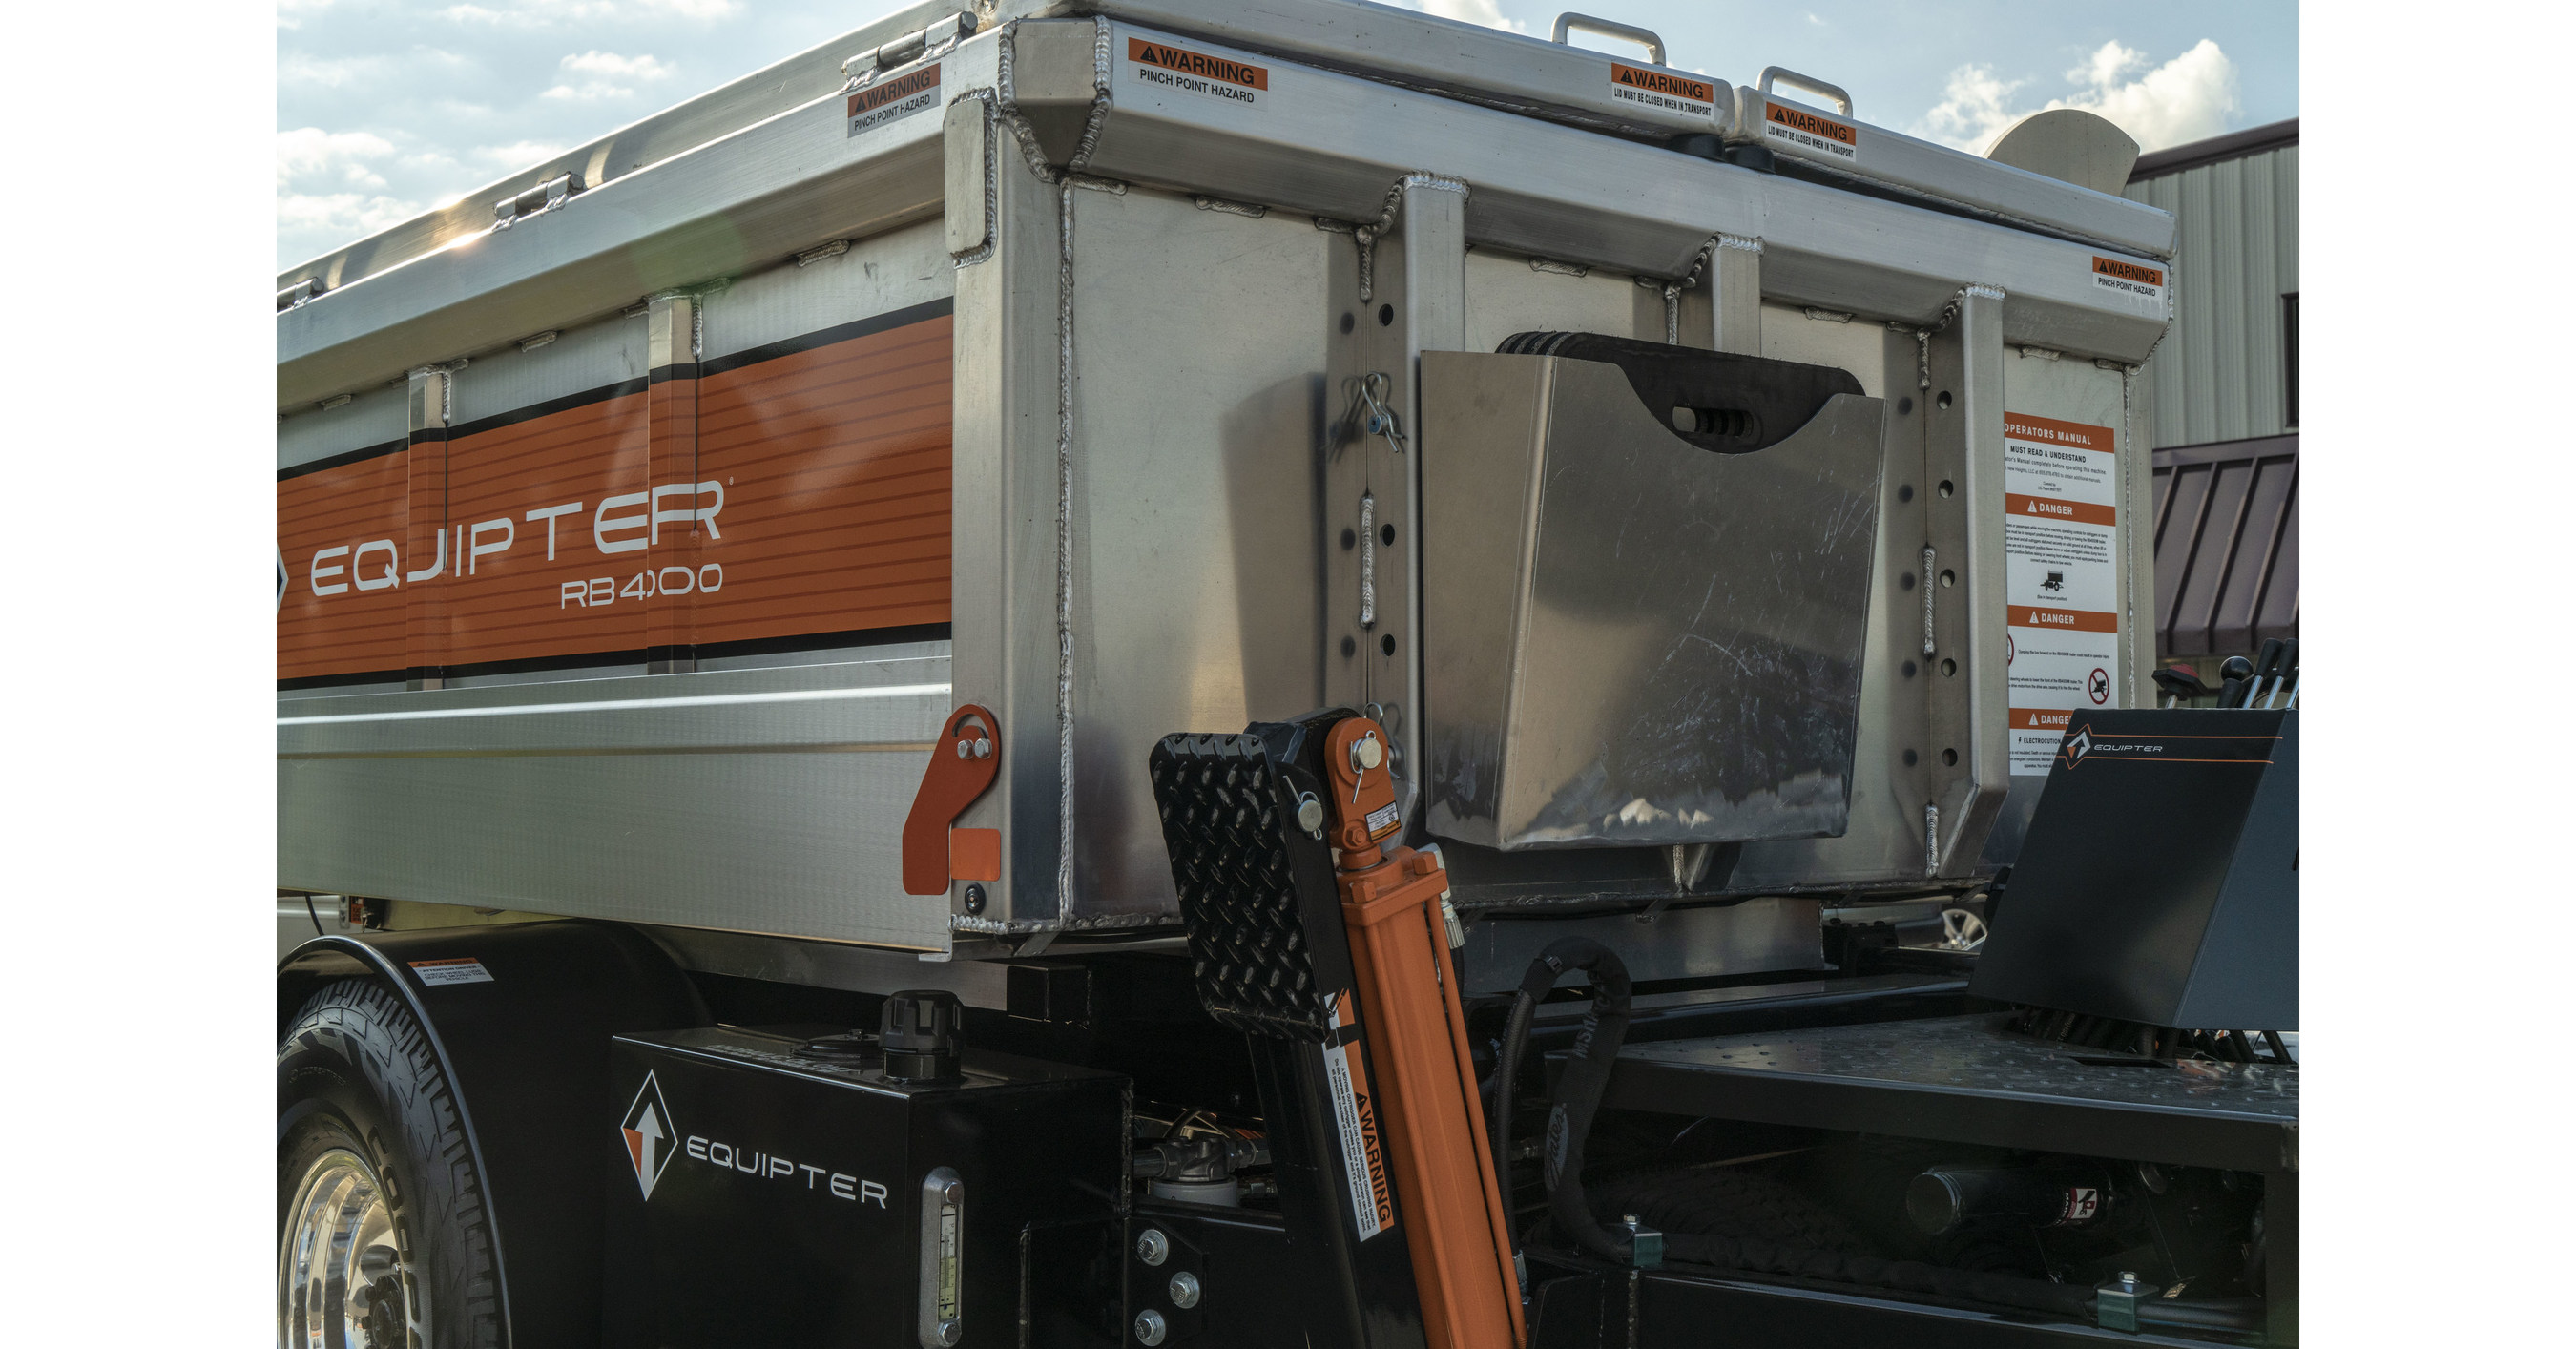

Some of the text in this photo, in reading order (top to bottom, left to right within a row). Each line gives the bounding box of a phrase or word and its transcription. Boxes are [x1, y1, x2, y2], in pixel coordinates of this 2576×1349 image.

[1159, 48, 1255, 85] WARNING
[866, 70, 930, 108] WARNING
[1140, 68, 1255, 103] PINCH POINT HAZARD
[1634, 71, 1703, 99] WARNING
[854, 93, 930, 131] PINCH POINT HAZARD
[1623, 89, 1636, 101] MUST
[1637, 92, 1644, 102] BE
[1645, 93, 1663, 107] CLOSED
[1664, 98, 1677, 110] WHEN
[1678, 100, 1684, 111] IN
[1684, 102, 1711, 116] TRANSPORT
[1786, 110, 1847, 141] WARNING
[1776, 127, 1788, 138] MUST
[1788, 130, 1795, 141] BE
[1795, 133, 1811, 146] CLOSED
[1812, 136, 1823, 150] WHEN
[1824, 141, 1829, 152] IN
[1830, 143, 1854, 158] TRANSPORT
[2109, 261, 2156, 283] WARNING
[2098, 277, 2156, 297] PINCH POINT HAZARD
[2004, 423, 2091, 445] OPERATORS MANUAL
[2010, 446, 2025, 454] MUST
[2027, 448, 2043, 458] READ
[2049, 451, 2087, 463] UNDERSTAND
[2039, 503, 2073, 515] DANGER
[310, 479, 724, 597] EQUIPTER
[2041, 613, 2075, 625] DANGER
[2041, 715, 2071, 725] DANGE
[2094, 744, 2163, 753] EQUIPTER
[686, 1135, 888, 1209] EQUIPTER
[1359, 1110, 1391, 1223] WARNING
[367, 1123, 423, 1349] COOP
